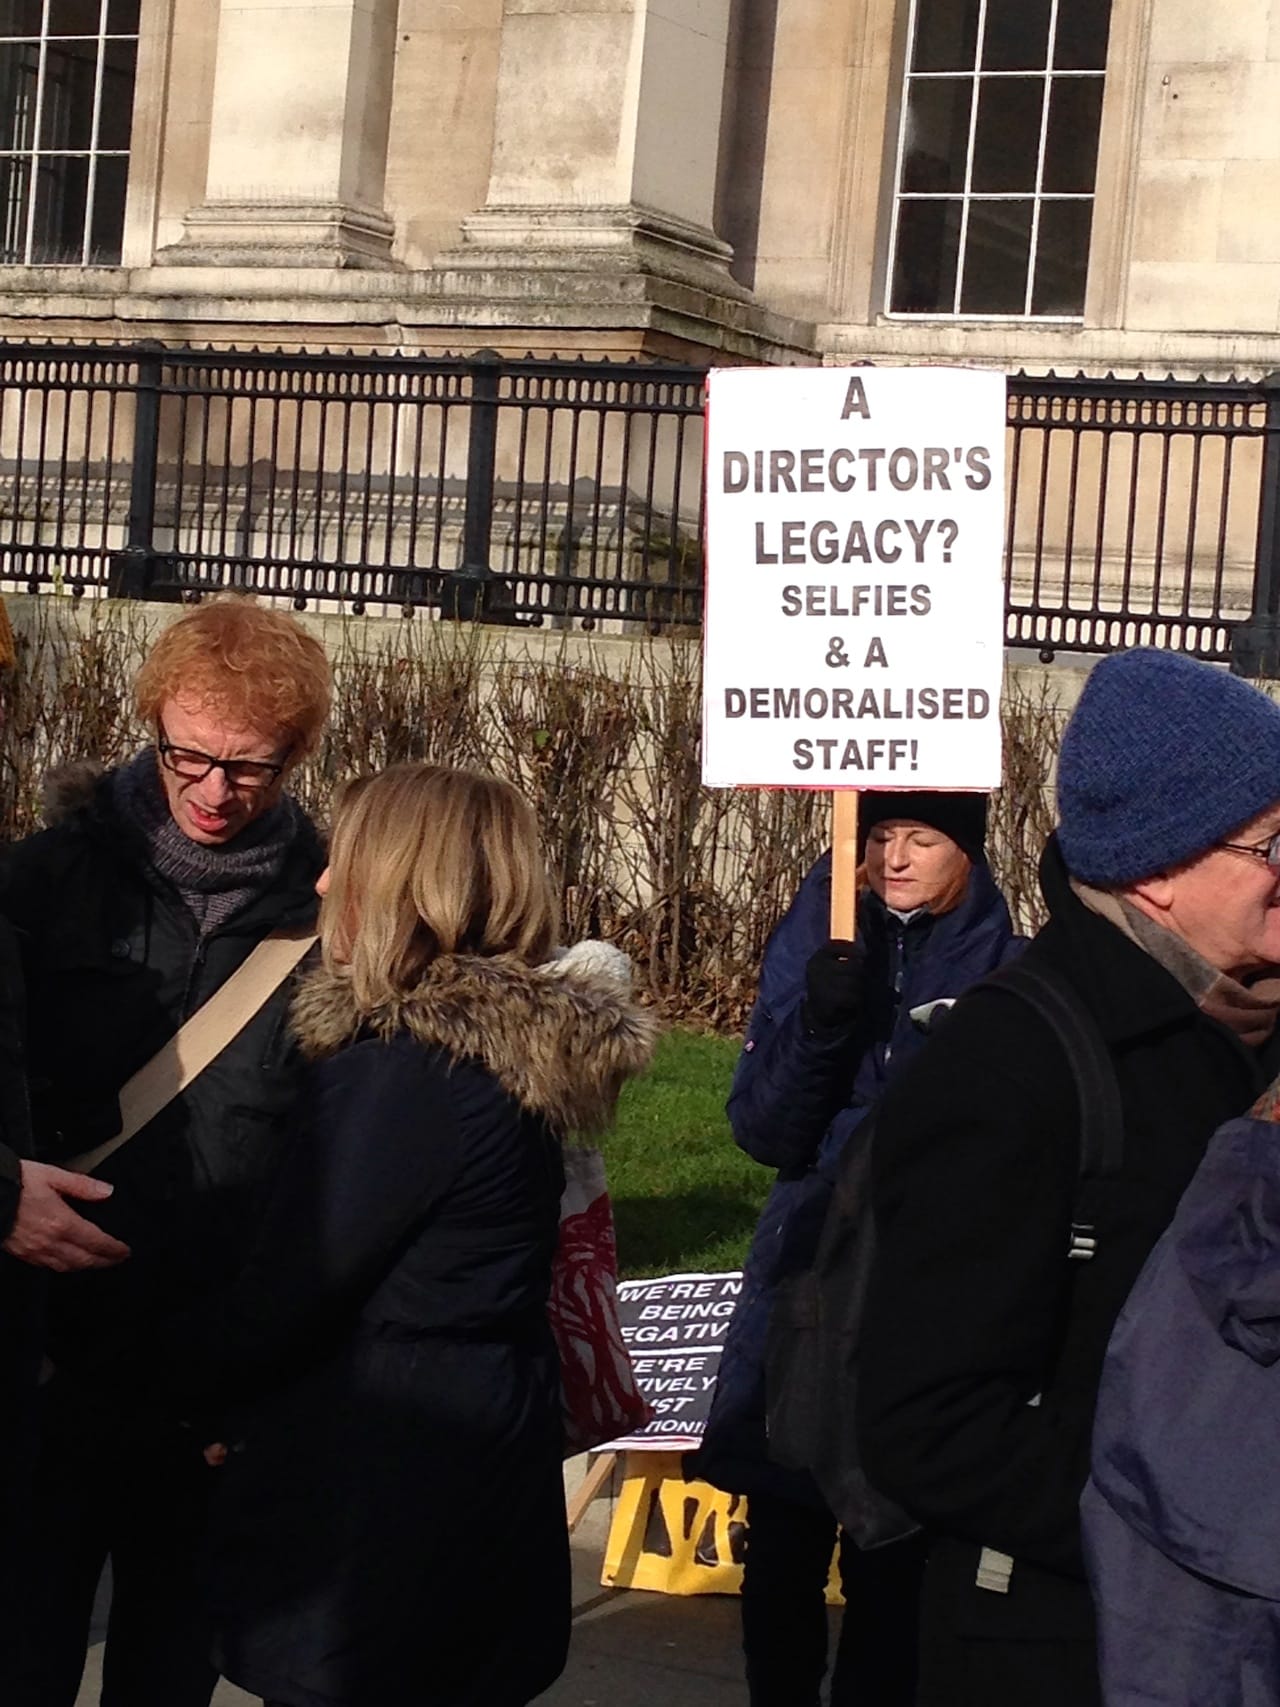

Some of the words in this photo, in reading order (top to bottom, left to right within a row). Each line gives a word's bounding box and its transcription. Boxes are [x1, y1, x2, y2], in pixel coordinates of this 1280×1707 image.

[841, 376, 870, 419] A
[724, 447, 991, 493] DIRECTOR'S
[756, 519, 958, 564] LEGACY?
[782, 584, 930, 616] SELFIES
[826, 637, 850, 668] &
[864, 637, 888, 667] A
[725, 688, 989, 719] DEMORALISED
[793, 739, 917, 770] STAFF!
[619, 1282, 715, 1302] WE'RE
[639, 1301, 736, 1321] BEING
[620, 1322, 730, 1342] EGATIV
[632, 1357, 708, 1374] E'RE
[635, 1376, 718, 1393] TIVELY
